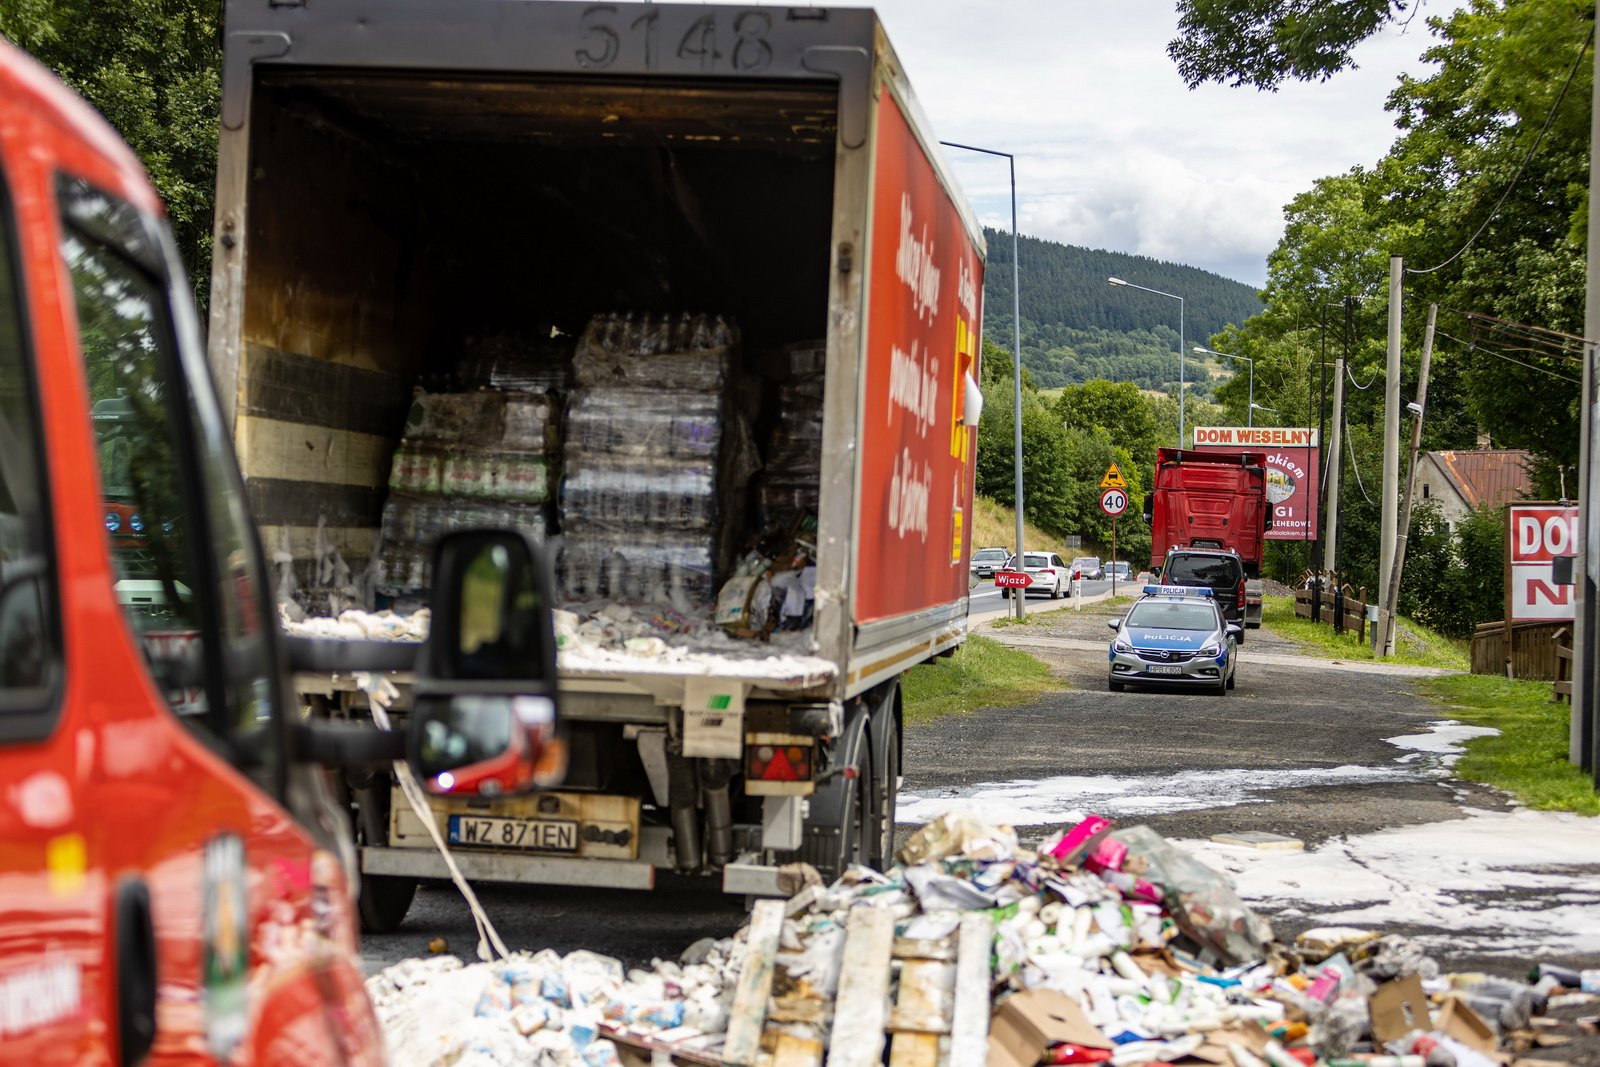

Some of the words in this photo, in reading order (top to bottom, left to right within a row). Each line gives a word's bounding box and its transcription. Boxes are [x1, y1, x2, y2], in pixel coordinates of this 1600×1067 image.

[575, 5, 772, 70] 5148
[1196, 430, 1232, 442] DOM
[1237, 430, 1314, 444] WESELNY
[1266, 453, 1304, 479] okiem
[1104, 495, 1124, 509] 40
[1519, 516, 1580, 554] DO
[998, 575, 1026, 586] Wjazd
[1162, 587, 1185, 595] POLICJA
[1144, 634, 1192, 642] POLICJA
[465, 820, 492, 843] WZ
[502, 822, 572, 849] 871EN
